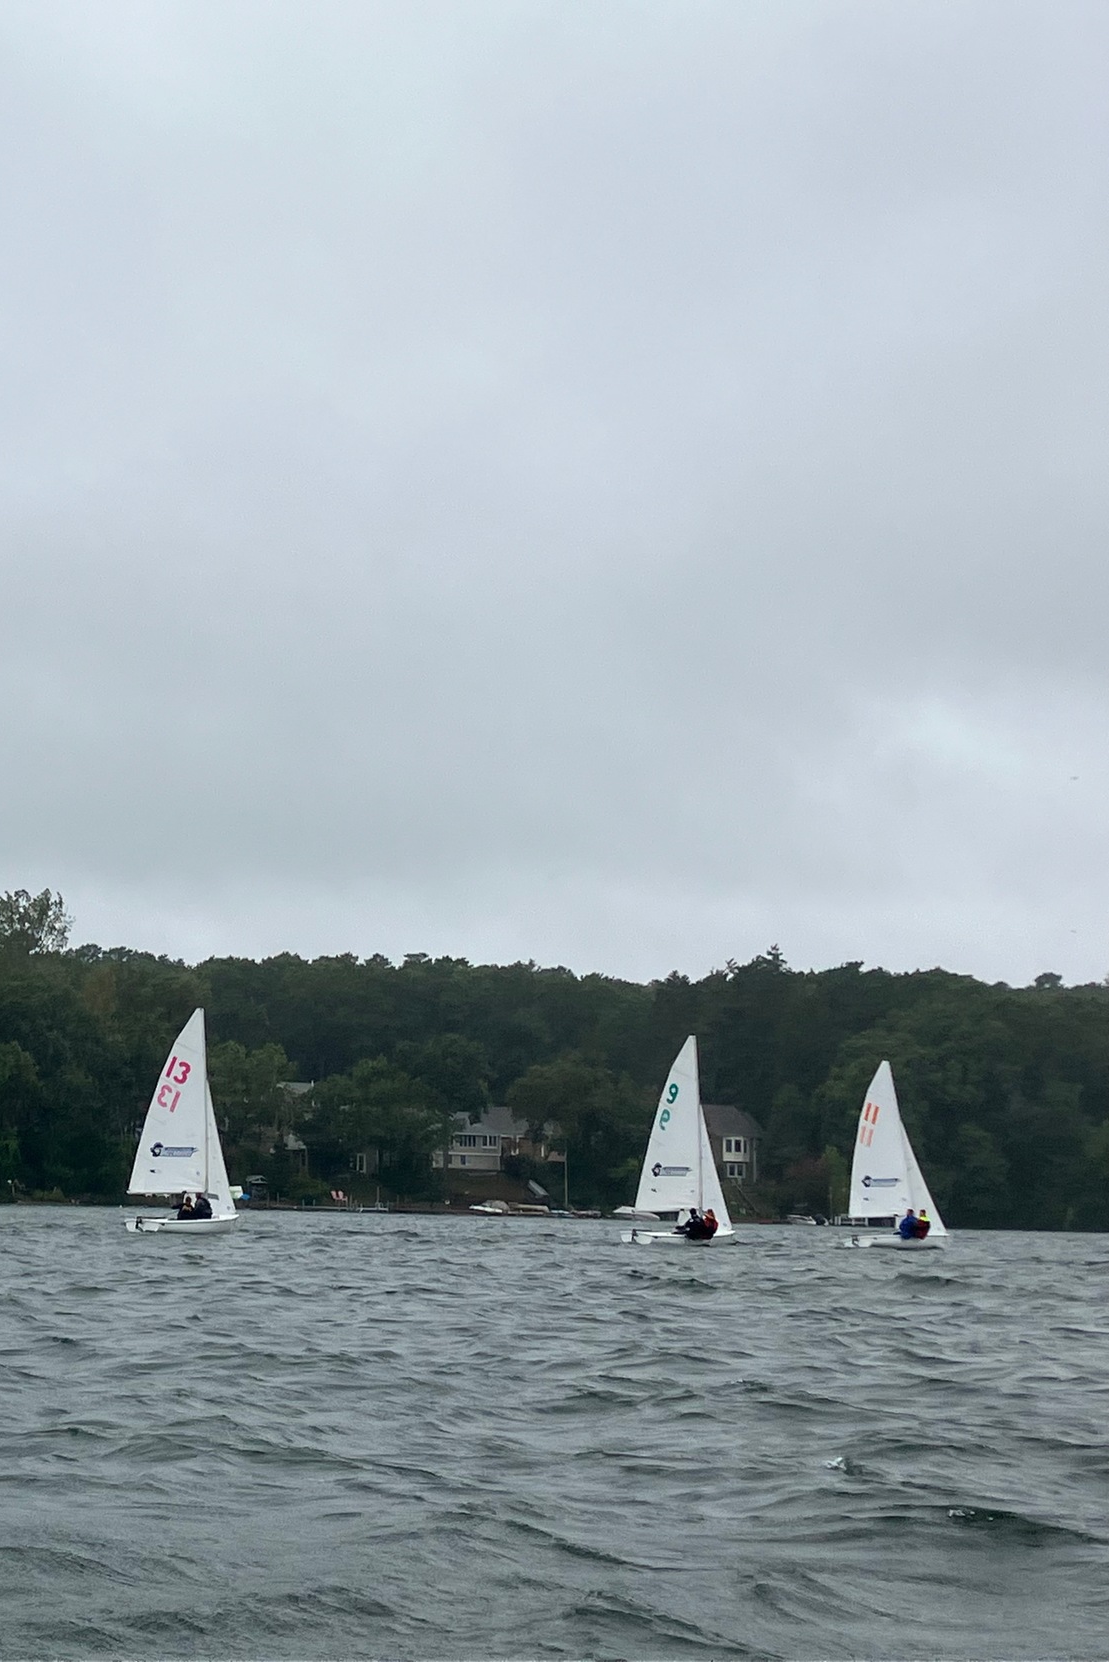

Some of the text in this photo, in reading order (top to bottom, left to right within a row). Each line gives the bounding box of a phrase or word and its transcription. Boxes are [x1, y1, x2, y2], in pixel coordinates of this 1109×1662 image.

[165, 1055, 191, 1085] 13
[666, 1083, 679, 1105] 9
[863, 1102, 880, 1125] 11
